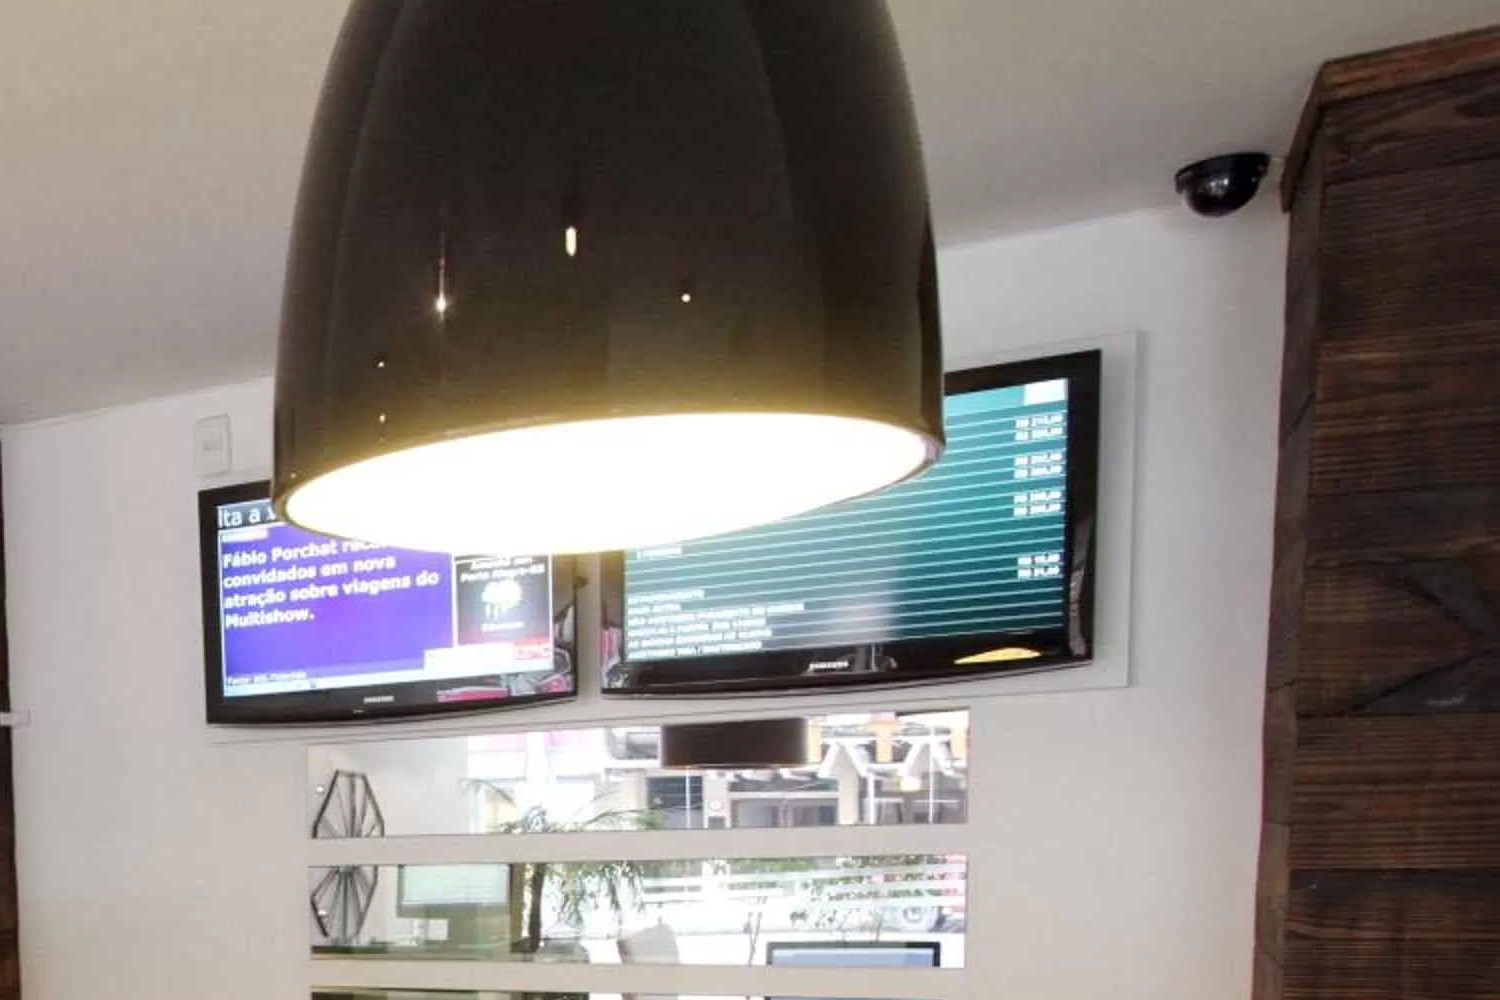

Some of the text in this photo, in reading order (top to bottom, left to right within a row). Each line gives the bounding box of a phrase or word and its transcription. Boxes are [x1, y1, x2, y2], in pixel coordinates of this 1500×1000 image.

[223, 550, 267, 569] Fábio
[271, 540, 338, 562] Porchat
[223, 556, 396, 588] convidados em nova
[224, 570, 440, 610] atração sobre viagens do
[225, 608, 316, 629] Multishow.
